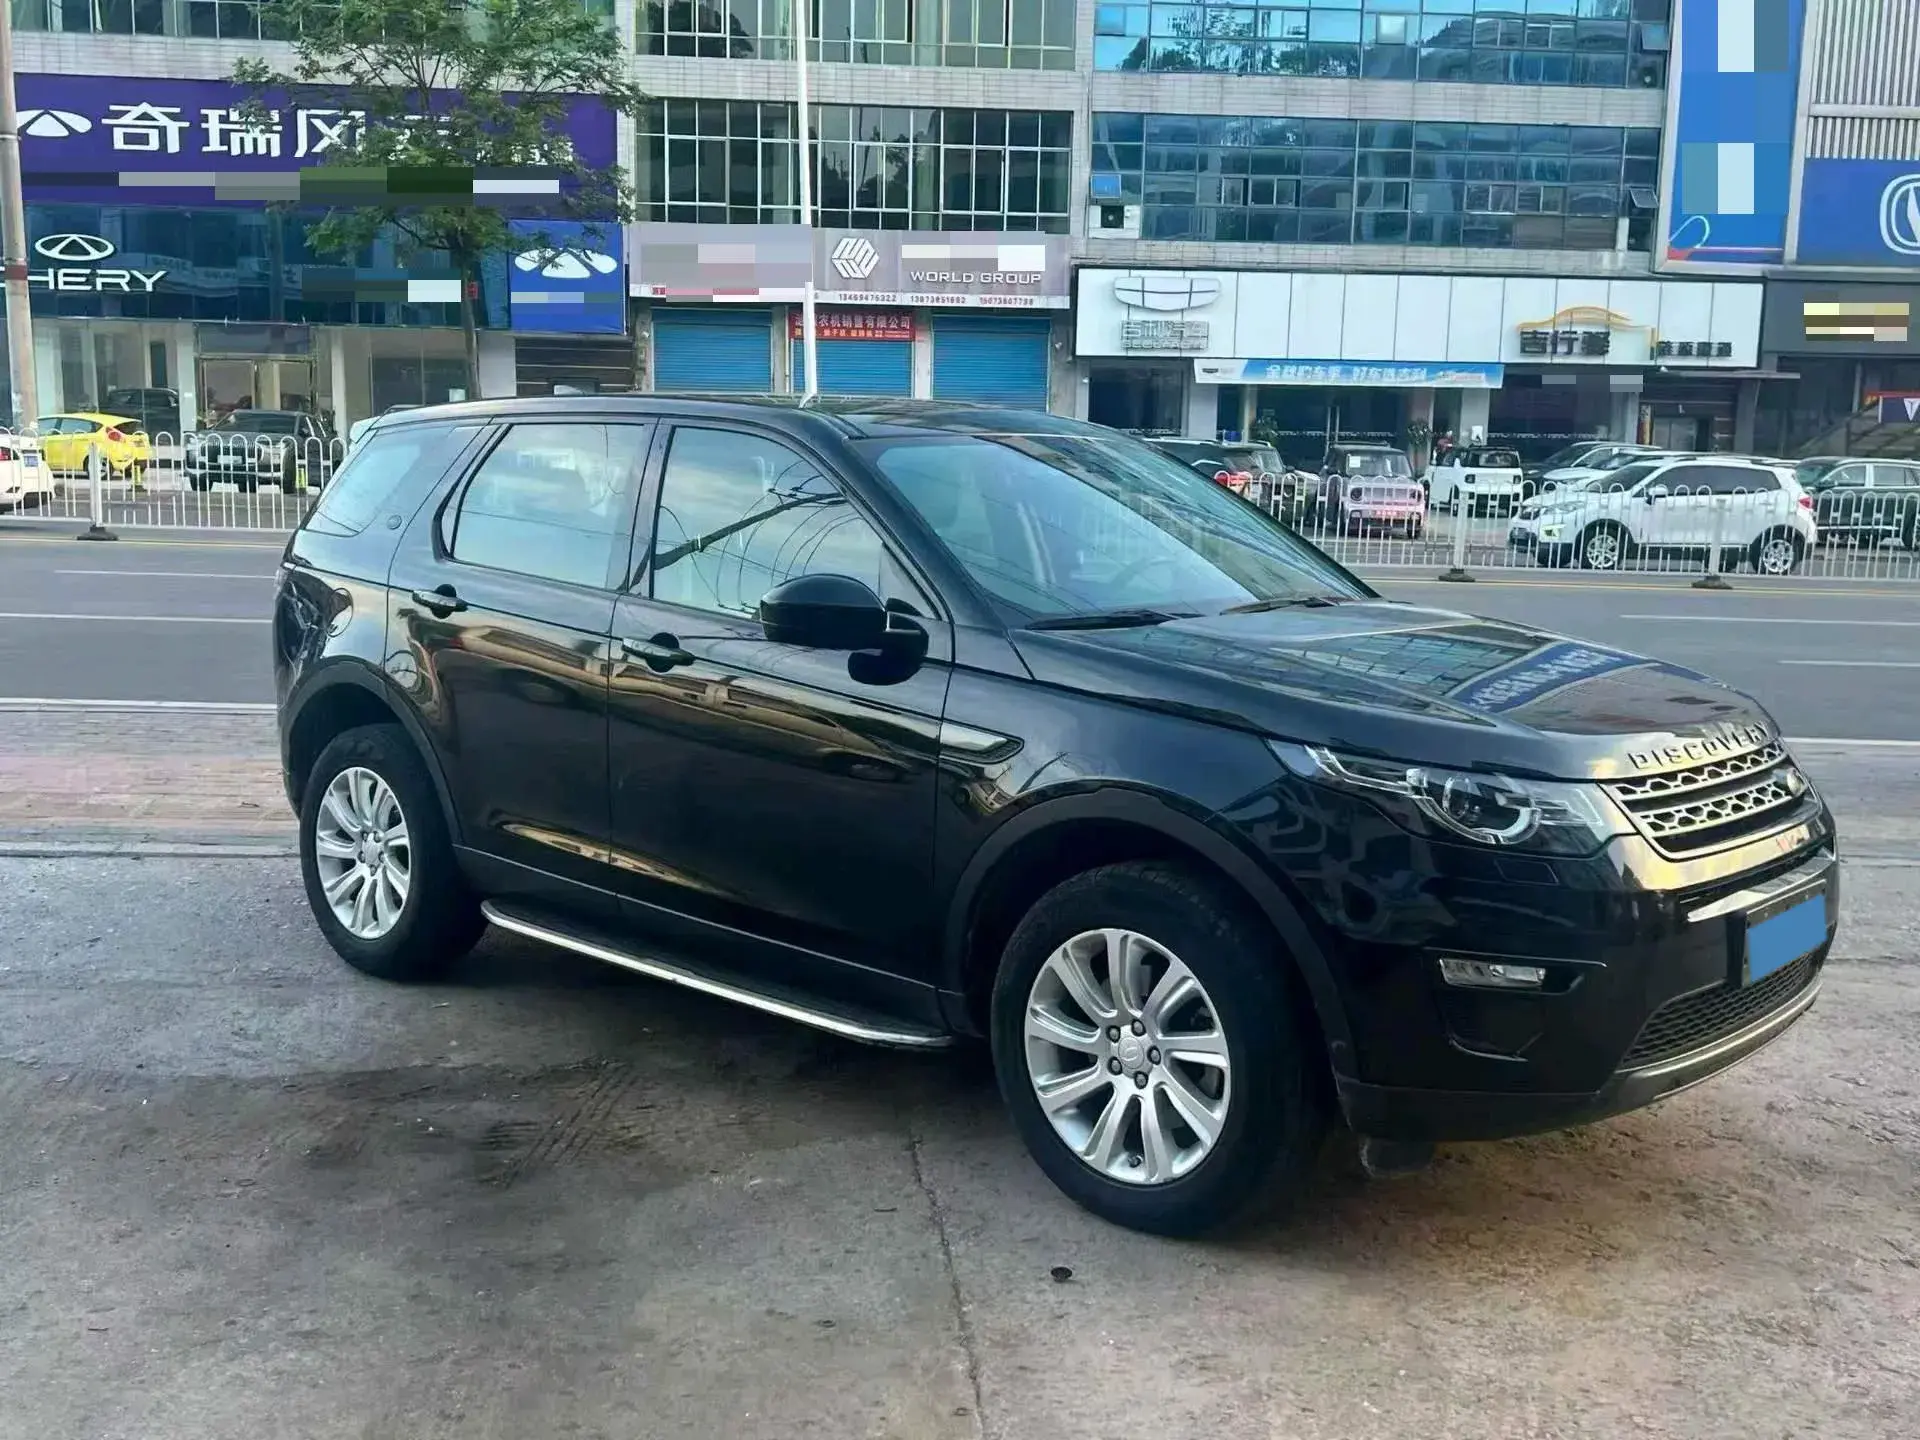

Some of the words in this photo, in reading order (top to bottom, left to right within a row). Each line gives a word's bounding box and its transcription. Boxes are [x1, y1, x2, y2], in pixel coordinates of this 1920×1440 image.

[0, 266, 168, 292] HERY
[910, 271, 975, 284] WORLD
[979, 272, 1042, 285] GROUP
[1627, 721, 1770, 770] DISCOVERY
